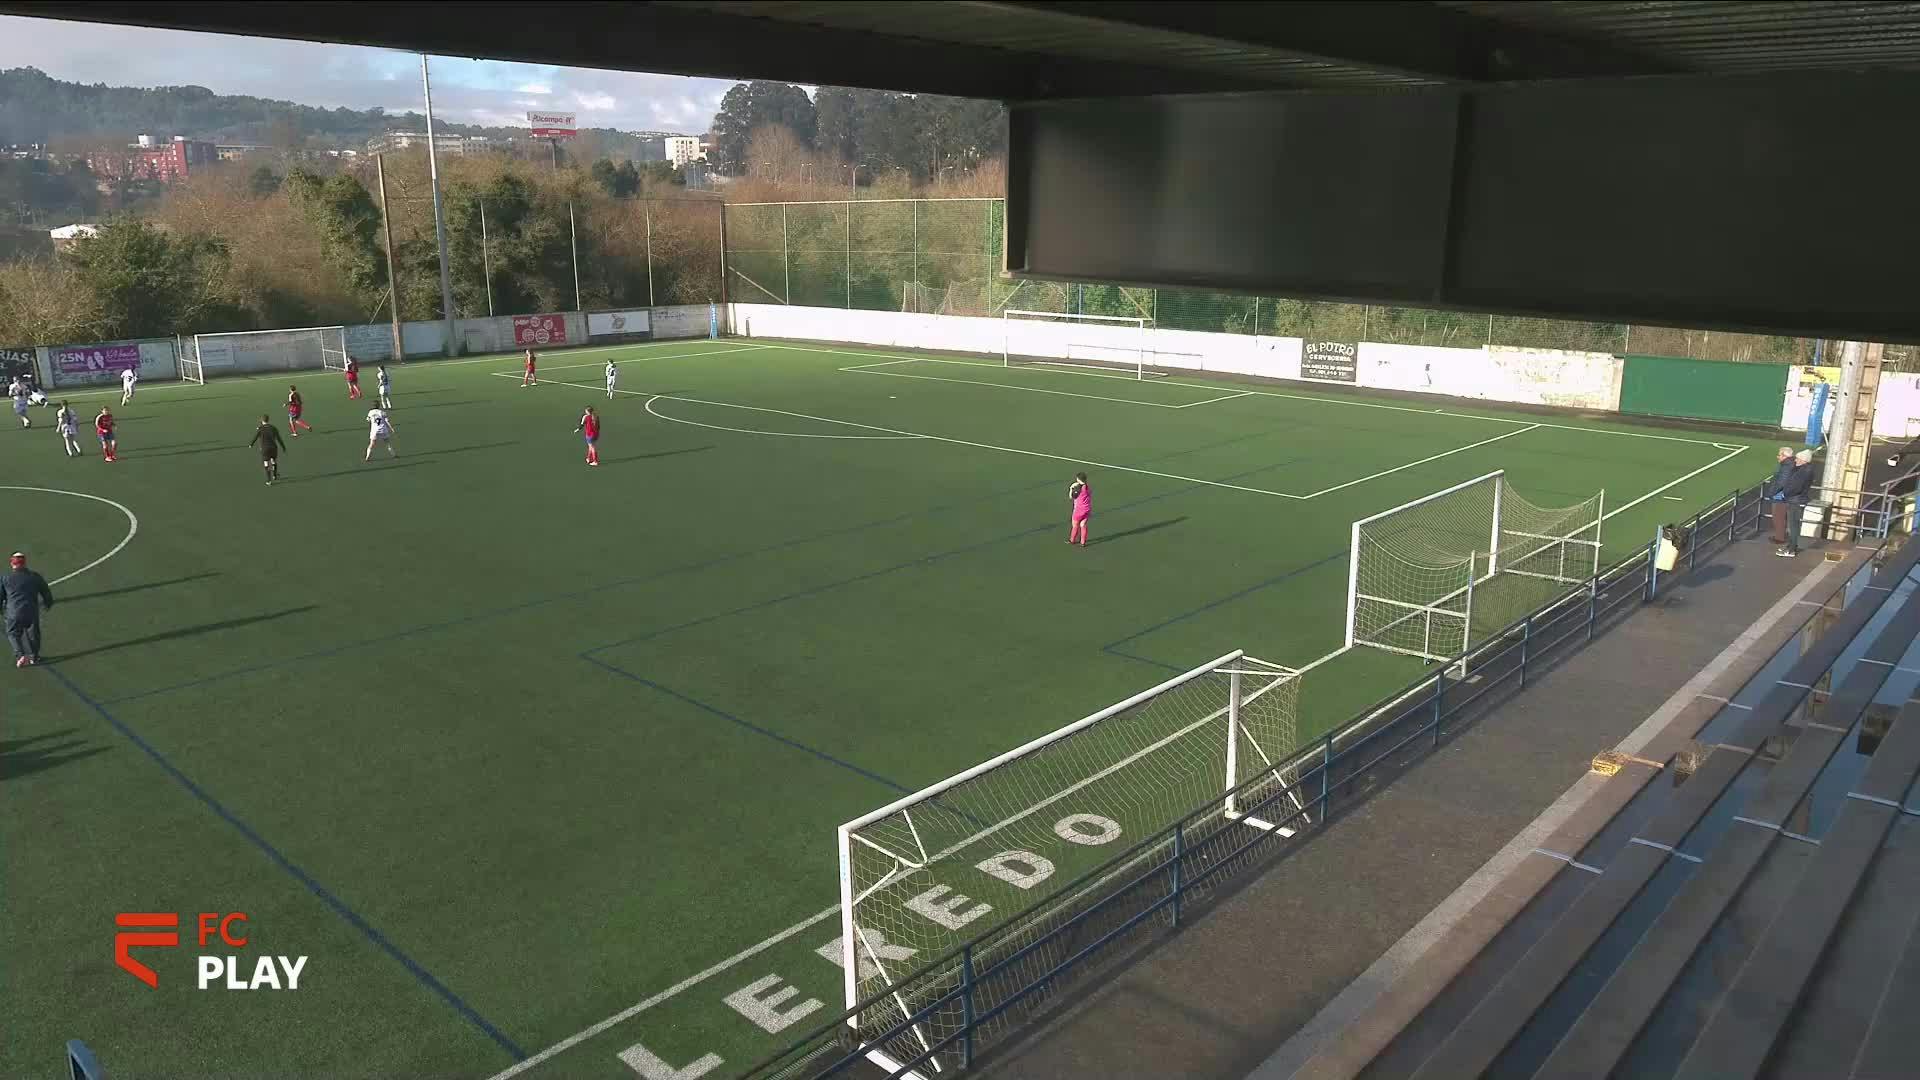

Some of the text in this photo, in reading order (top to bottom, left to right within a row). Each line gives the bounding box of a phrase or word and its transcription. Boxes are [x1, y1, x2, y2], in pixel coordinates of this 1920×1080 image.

[1306, 341, 1355, 357] EL POTRO
[60, 352, 84, 363] 25N
[617, 812, 1123, 1080] LEREDO
